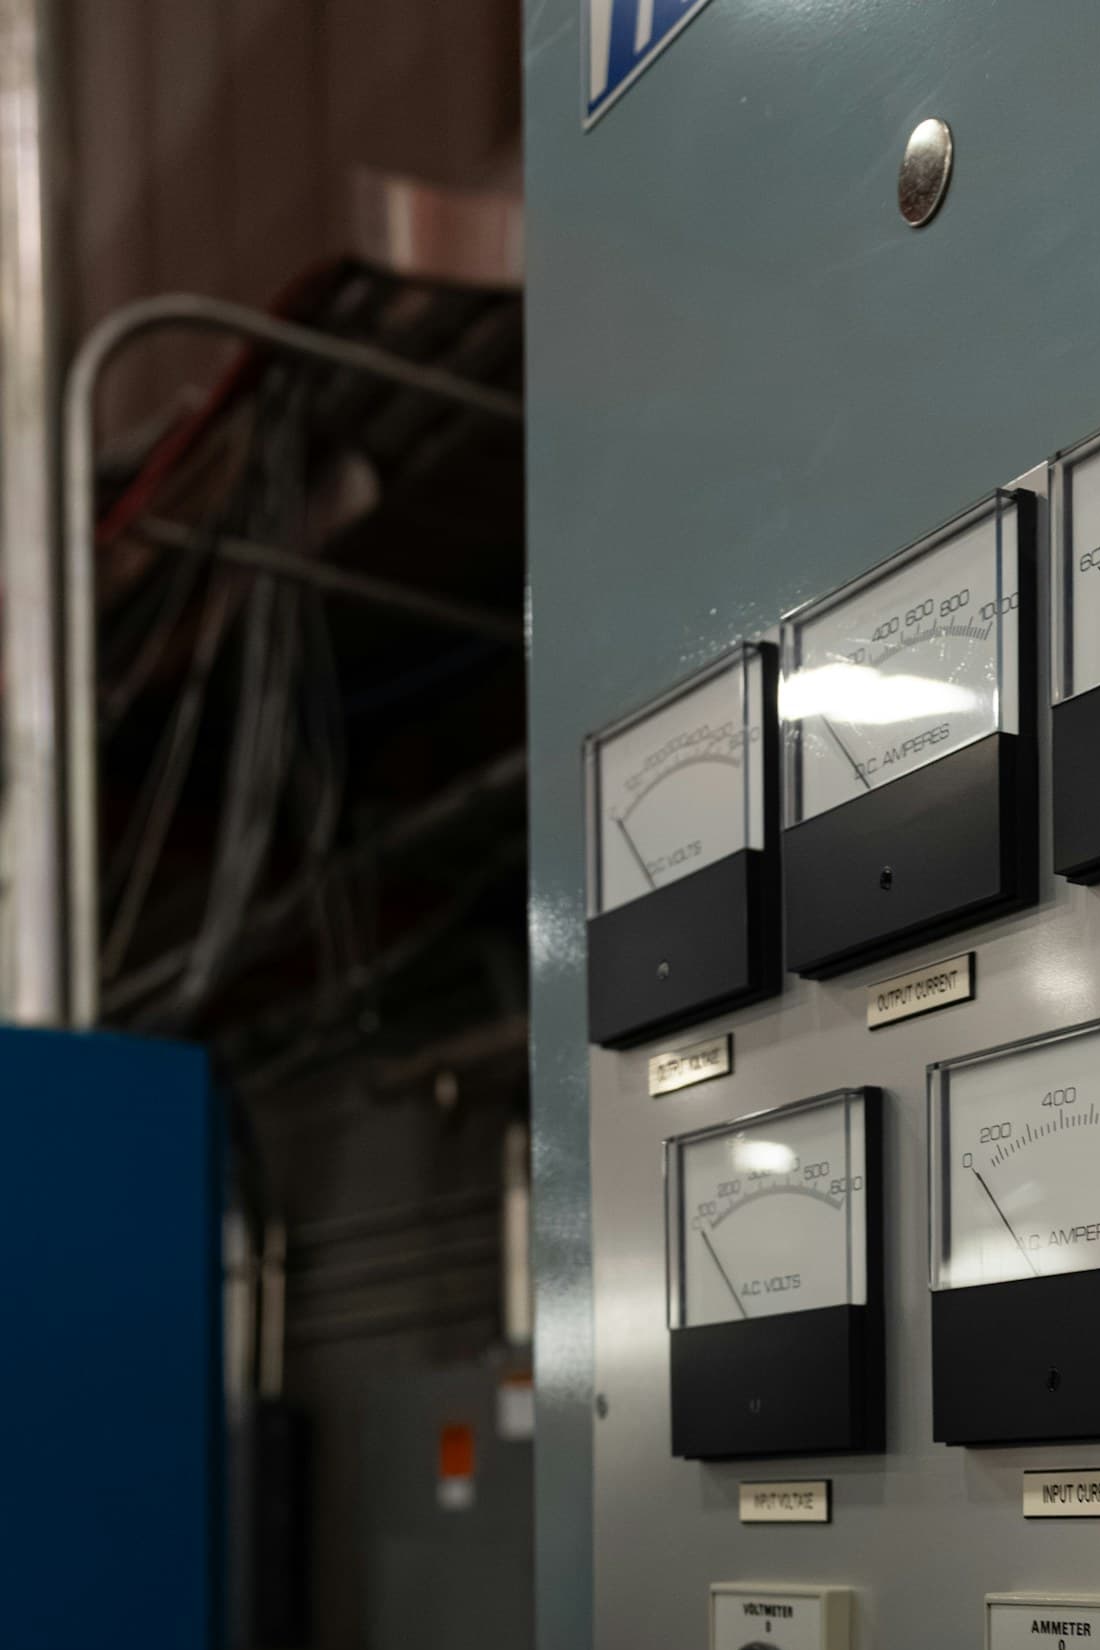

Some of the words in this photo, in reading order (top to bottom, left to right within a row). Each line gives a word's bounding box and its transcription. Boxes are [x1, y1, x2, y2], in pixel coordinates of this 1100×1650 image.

[882, 723, 950, 767] AMPERES
[878, 984, 913, 1012] OUTPUT
[915, 970, 958, 1000] CURRENT
[1041, 1087, 1076, 1107] 400
[979, 1122, 1012, 1144] 200
[962, 1152, 973, 1168] 0
[765, 1273, 801, 1292] VOLTS
[1042, 1484, 1074, 1503] INPUT
[743, 1603, 793, 1618] VOLTMETER
[1031, 1619, 1091, 1637] AMMETER
